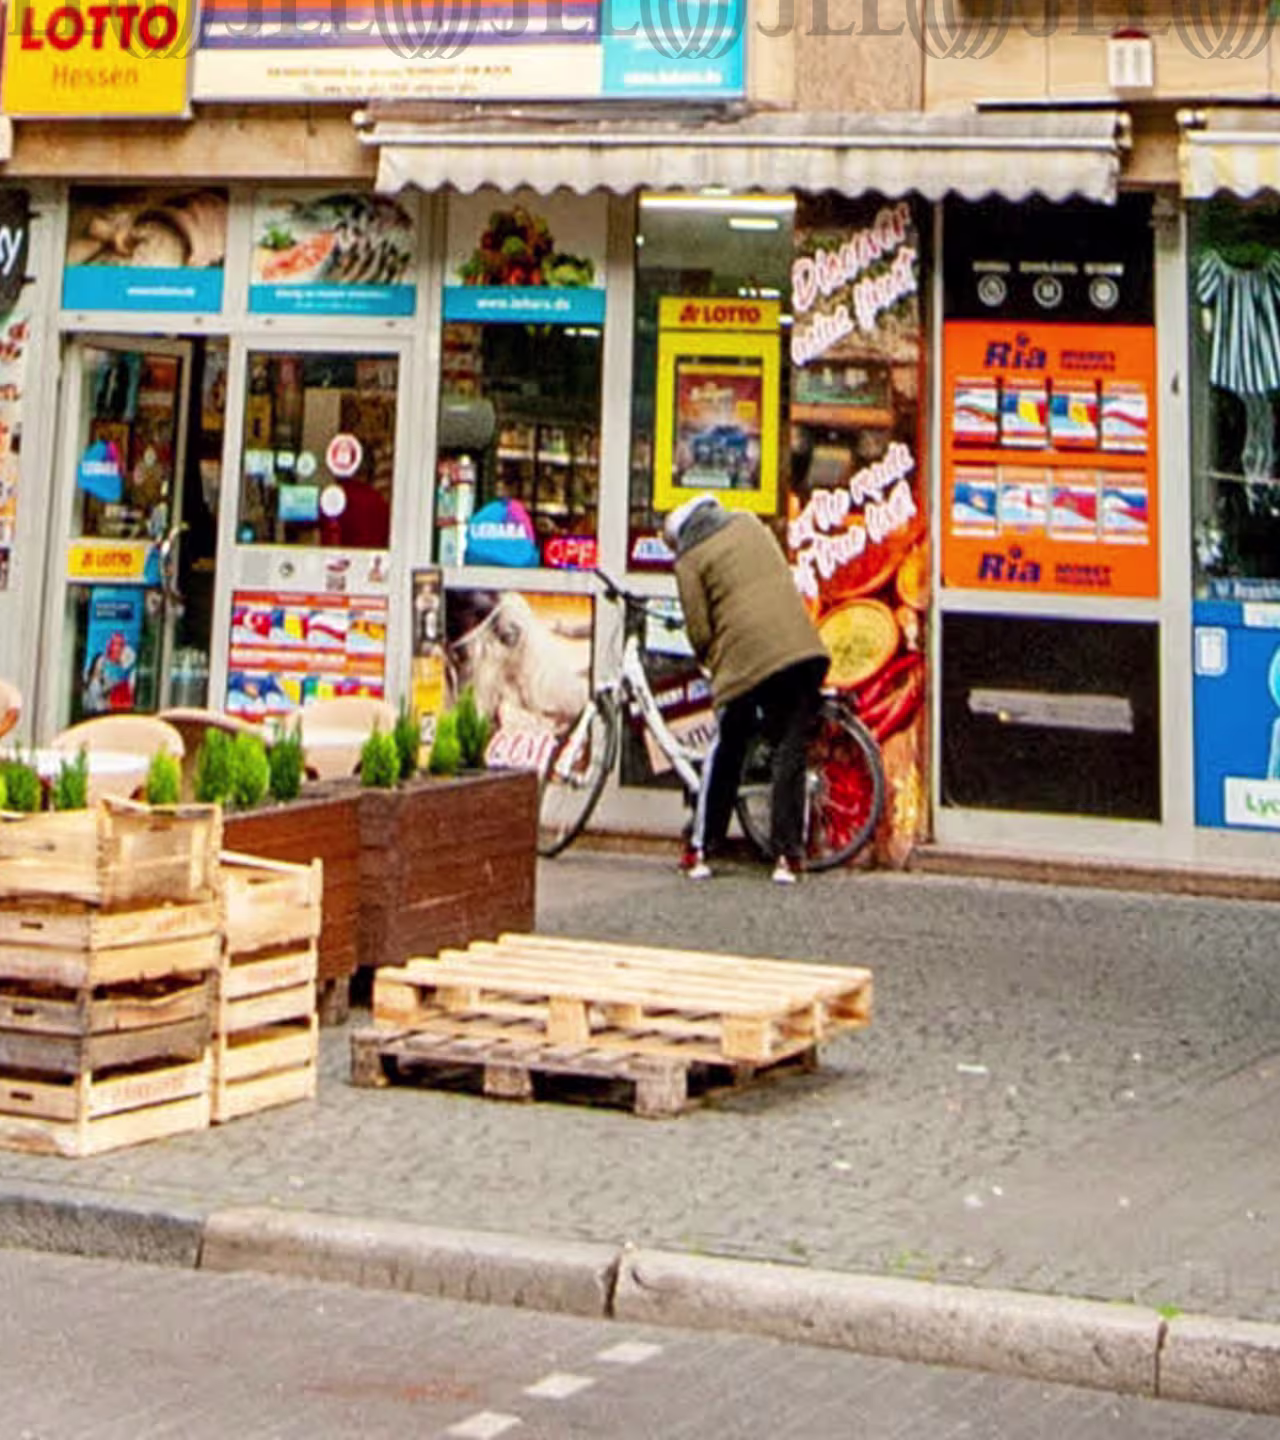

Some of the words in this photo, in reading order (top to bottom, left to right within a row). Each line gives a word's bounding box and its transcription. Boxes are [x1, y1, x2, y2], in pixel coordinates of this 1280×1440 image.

[22, 5, 178, 50] LOTTO
[53, 65, 138, 89] Hessen
[703, 305, 761, 324] LOTTO
[985, 333, 1047, 370] Ria
[96, 552, 133, 567] LOTTO
[978, 546, 1041, 583] Ria
